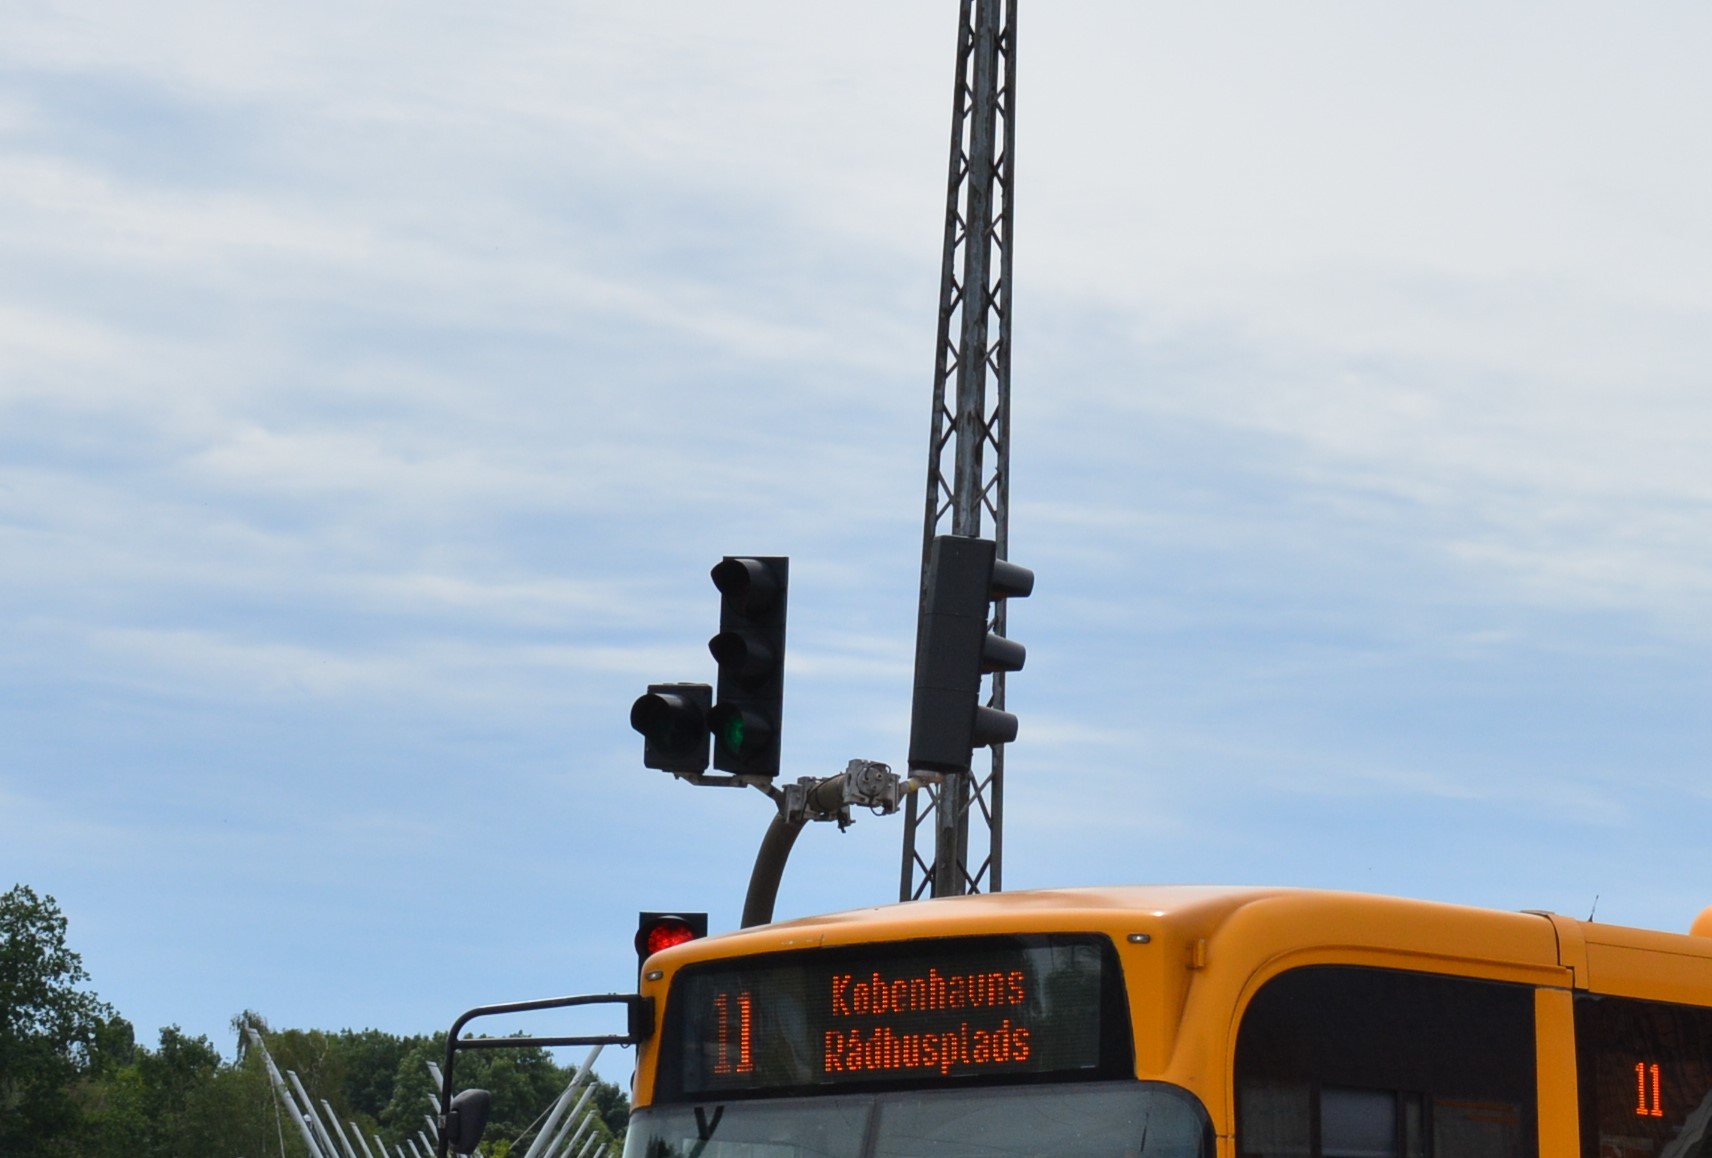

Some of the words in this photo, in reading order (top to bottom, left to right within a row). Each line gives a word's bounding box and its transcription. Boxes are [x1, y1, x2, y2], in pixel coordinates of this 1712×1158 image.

[833, 969, 1024, 1016] Københavns
[714, 992, 753, 1073] 11
[825, 1019, 1030, 1074] Rådhusplads
[1635, 1062, 1663, 1117] 11
